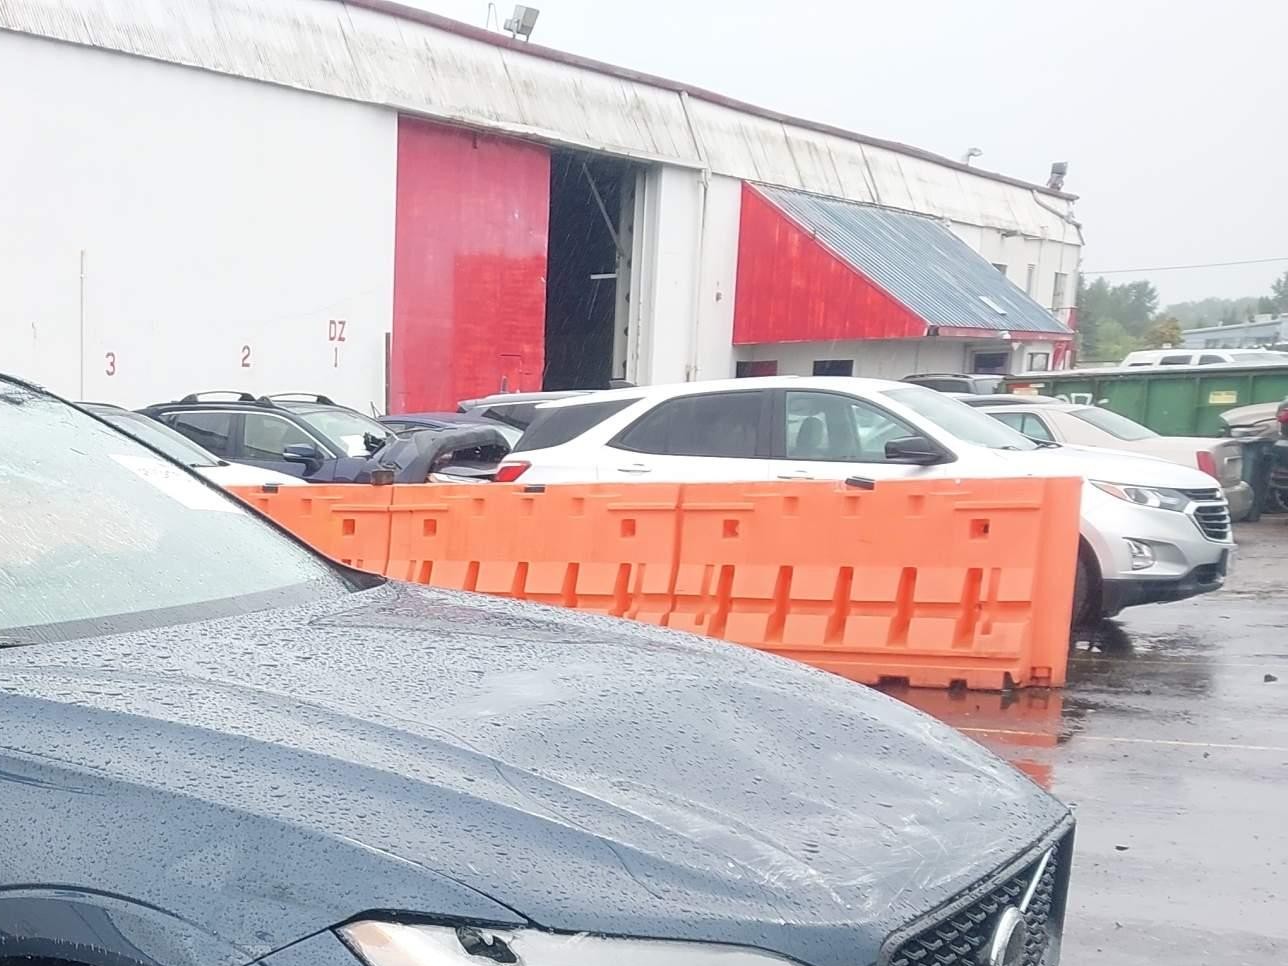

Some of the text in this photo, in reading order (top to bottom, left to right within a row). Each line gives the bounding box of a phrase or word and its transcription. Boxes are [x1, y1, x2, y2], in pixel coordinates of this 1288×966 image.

[328, 319, 346, 341] DZ
[105, 351, 116, 376] 3
[241, 344, 251, 368] 2
